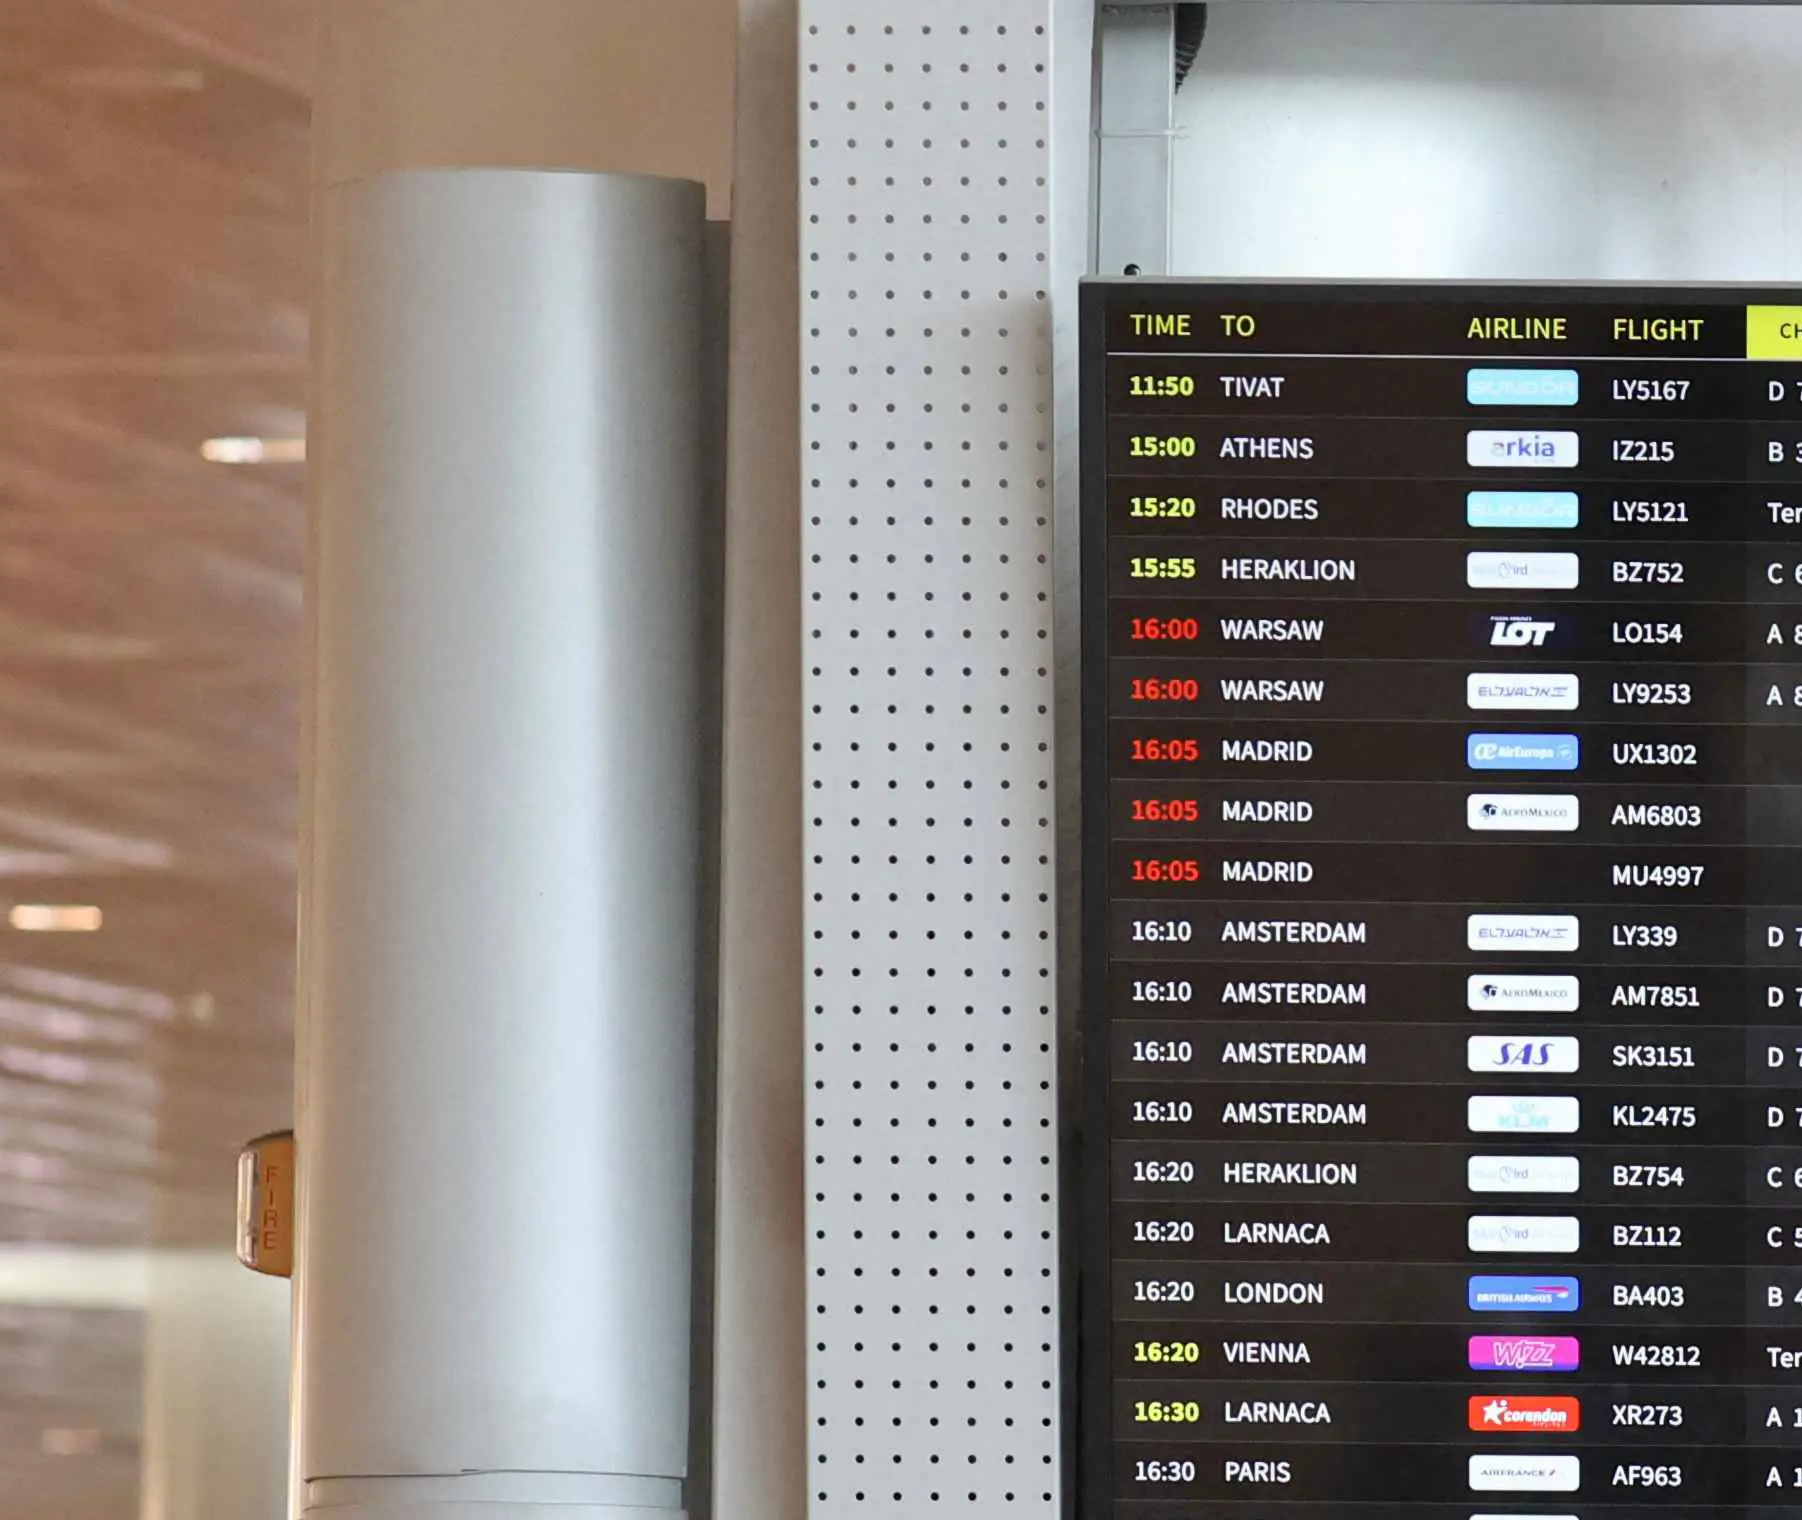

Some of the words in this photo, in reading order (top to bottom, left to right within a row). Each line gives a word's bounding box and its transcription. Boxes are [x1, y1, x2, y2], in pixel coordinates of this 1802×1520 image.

[1129, 314, 1191, 336] TIME
[1220, 314, 1255, 337] TO
[1467, 317, 1567, 340] AIRLINE
[1613, 318, 1705, 341] FLIGHT
[1130, 436, 1196, 457] 15:00
[1219, 437, 1314, 460] ATHENS
[1490, 435, 1555, 457] arkia
[1612, 439, 1675, 462] IZ215
[1768, 441, 1785, 463] B
[1131, 617, 1199, 640] 16:00
[1220, 619, 1324, 641] WARSAW
[1490, 620, 1556, 646] LOT
[1612, 621, 1683, 644] LO154
[1766, 623, 1783, 645] A
[1132, 799, 1199, 822] 16:05
[1222, 800, 1313, 822] MADRID
[1611, 804, 1701, 827] AM6803
[1132, 1041, 1193, 1062] 16:10
[1221, 1042, 1366, 1065] AMSTERDAM
[1493, 1042, 1555, 1065] SAS
[1612, 1045, 1695, 1067] SK3151
[1767, 1046, 1784, 1068] D
[263, 1164, 279, 1250] FIRE
[1134, 1401, 1200, 1423] 16:30
[1225, 1401, 1331, 1424] LARNACA
[1504, 1408, 1567, 1424] corendon
[1612, 1404, 1683, 1426] XR273
[1766, 1406, 1783, 1428] A
